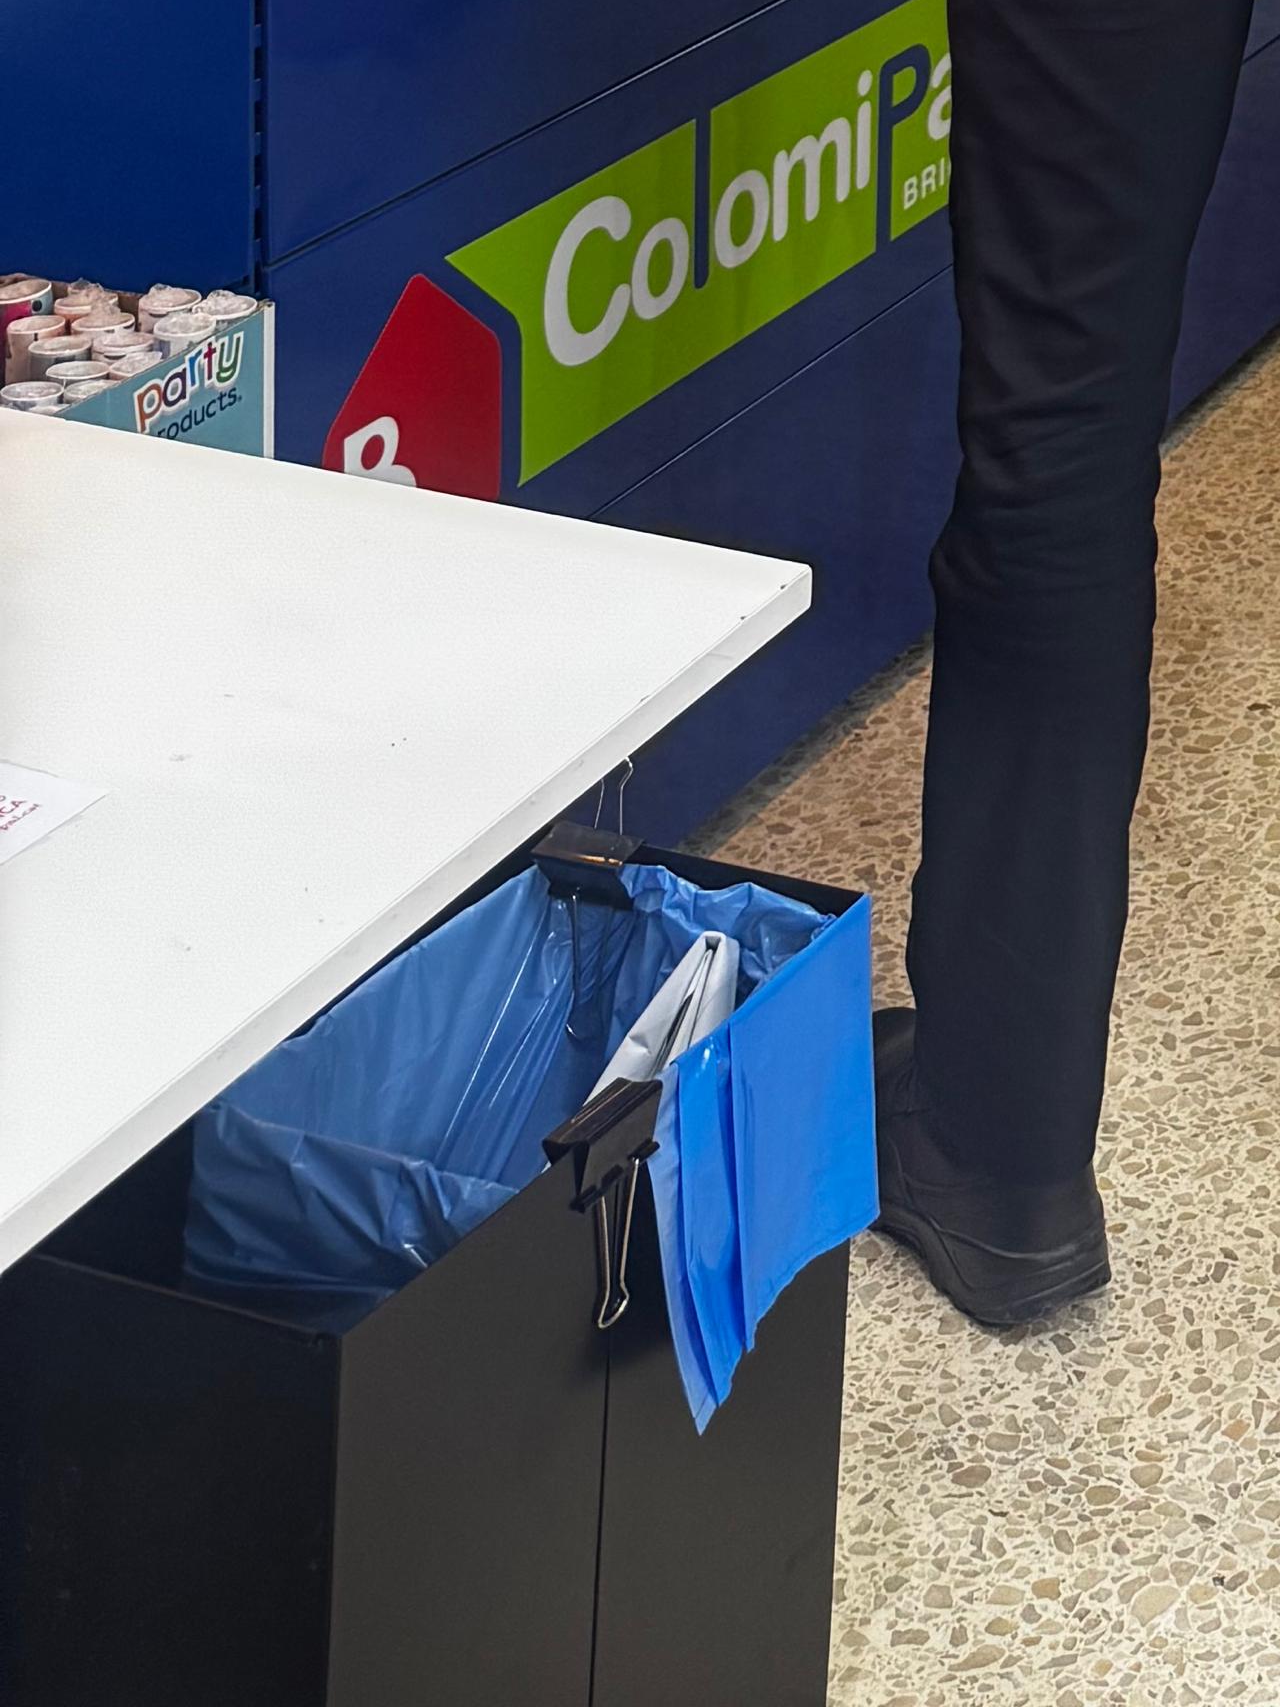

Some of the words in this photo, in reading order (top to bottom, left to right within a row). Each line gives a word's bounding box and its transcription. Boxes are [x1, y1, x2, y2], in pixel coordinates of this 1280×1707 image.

[543, 43, 952, 367] ColomiPa
[902, 157, 951, 211] BRI
[137, 336, 244, 434] party
